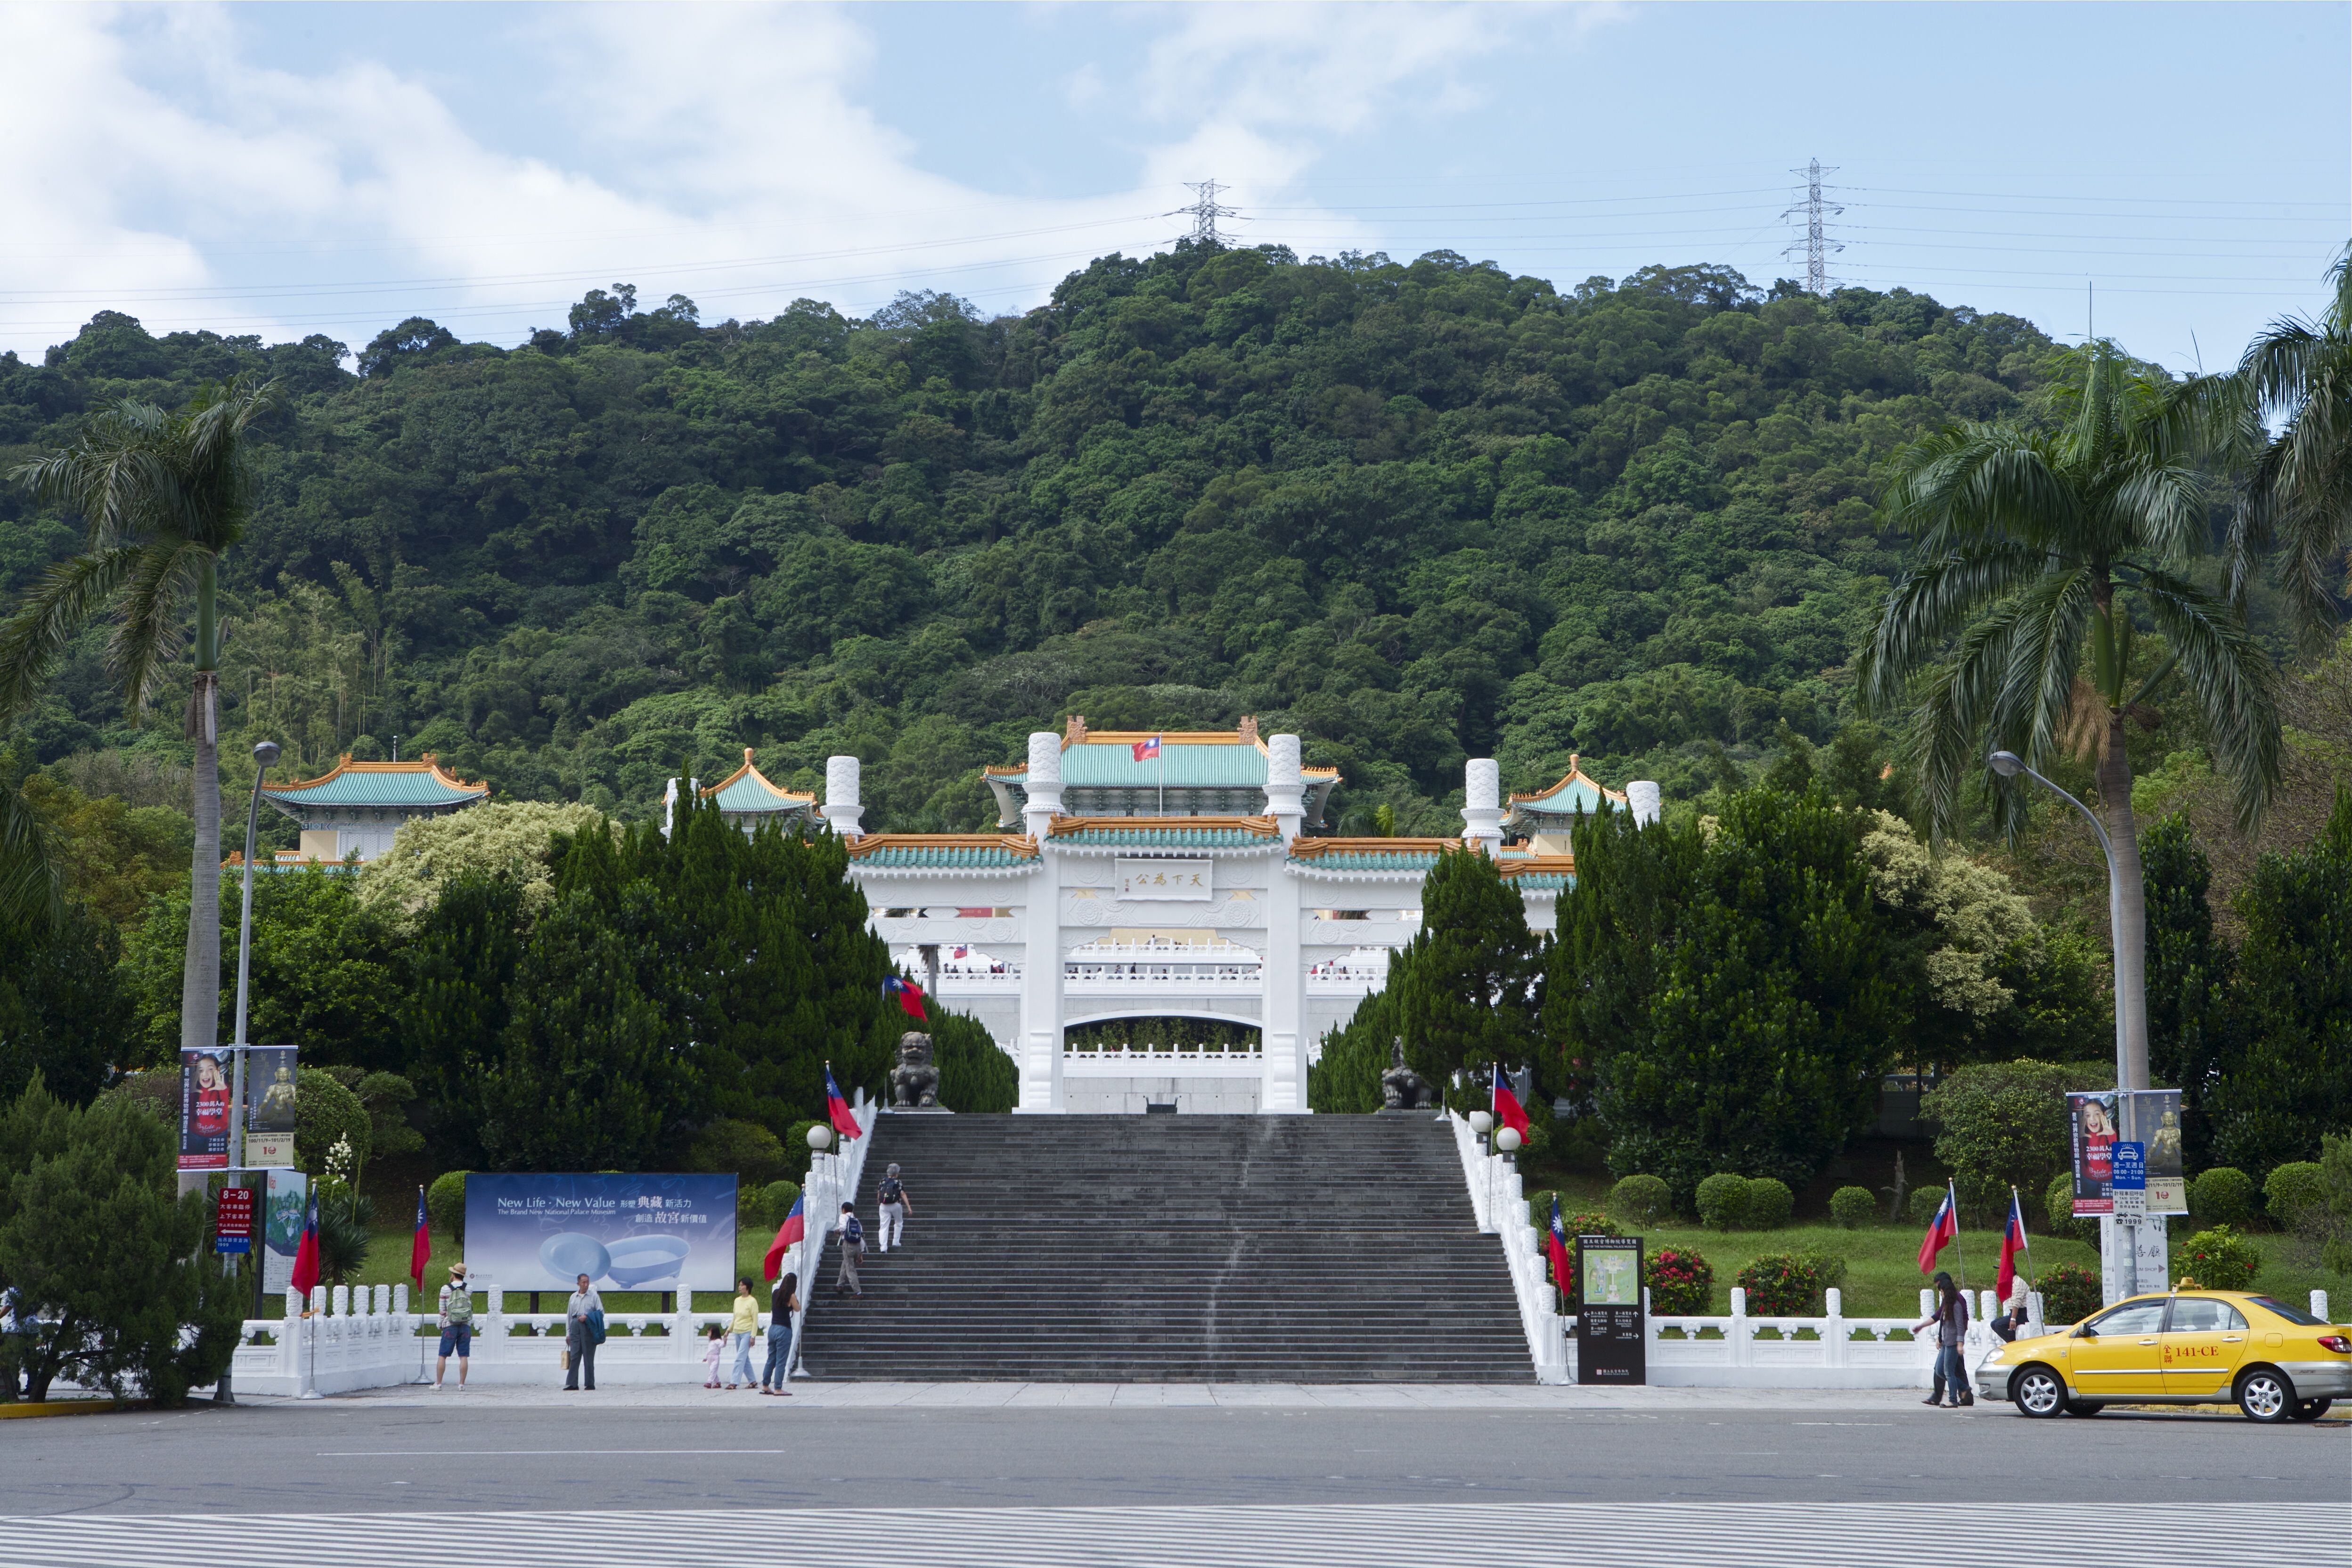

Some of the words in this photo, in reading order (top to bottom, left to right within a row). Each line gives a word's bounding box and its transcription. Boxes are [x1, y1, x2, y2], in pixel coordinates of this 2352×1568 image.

[268, 1176, 276, 1189] Map
[498, 1198, 523, 1208] New
[527, 1197, 546, 1208] Life
[556, 1198, 581, 1208] New
[584, 1197, 615, 1208] Value
[637, 1196, 662, 1209] 典藏
[665, 1199, 692, 1208] 新活力
[636, 1214, 653, 1223] 創造
[655, 1211, 679, 1224] 故宮
[680, 1214, 707, 1224] 新價值
[2164, 1344, 2173, 1364] 全聯
[2175, 1346, 2219, 1357] 141-CE
